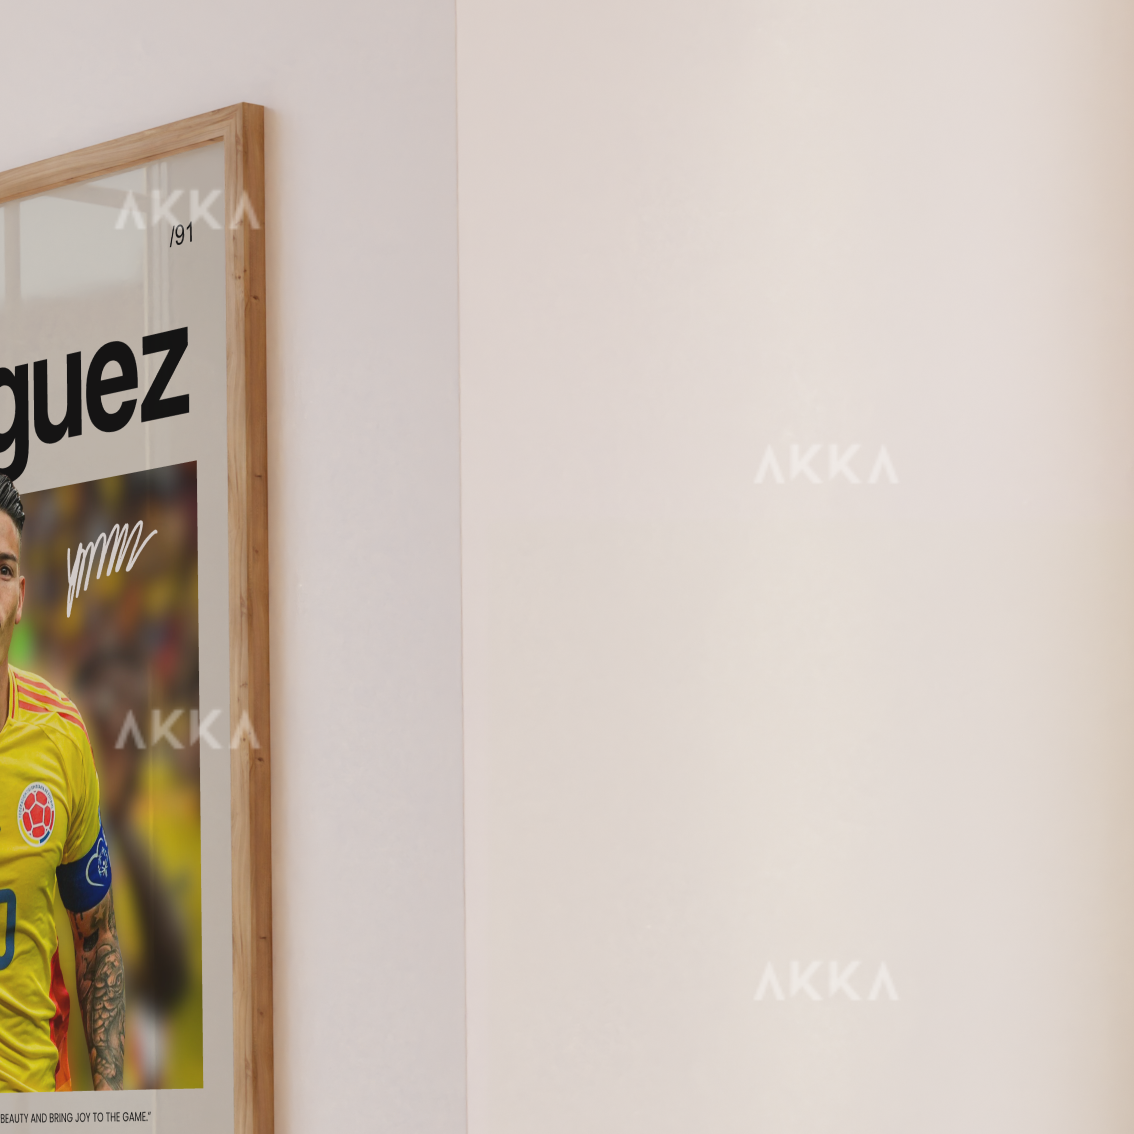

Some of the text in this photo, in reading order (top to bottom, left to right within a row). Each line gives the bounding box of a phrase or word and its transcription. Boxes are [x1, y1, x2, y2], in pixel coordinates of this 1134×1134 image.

[169, 222, 194, 248] /91
[0, 1113, 28, 1123] BEAUTY
[31, 1113, 47, 1123] AND
[49, 1112, 73, 1122] BRING
[76, 1112, 90, 1122] JOY
[93, 1112, 104, 1122] TO
[106, 1112, 120, 1122] THE
